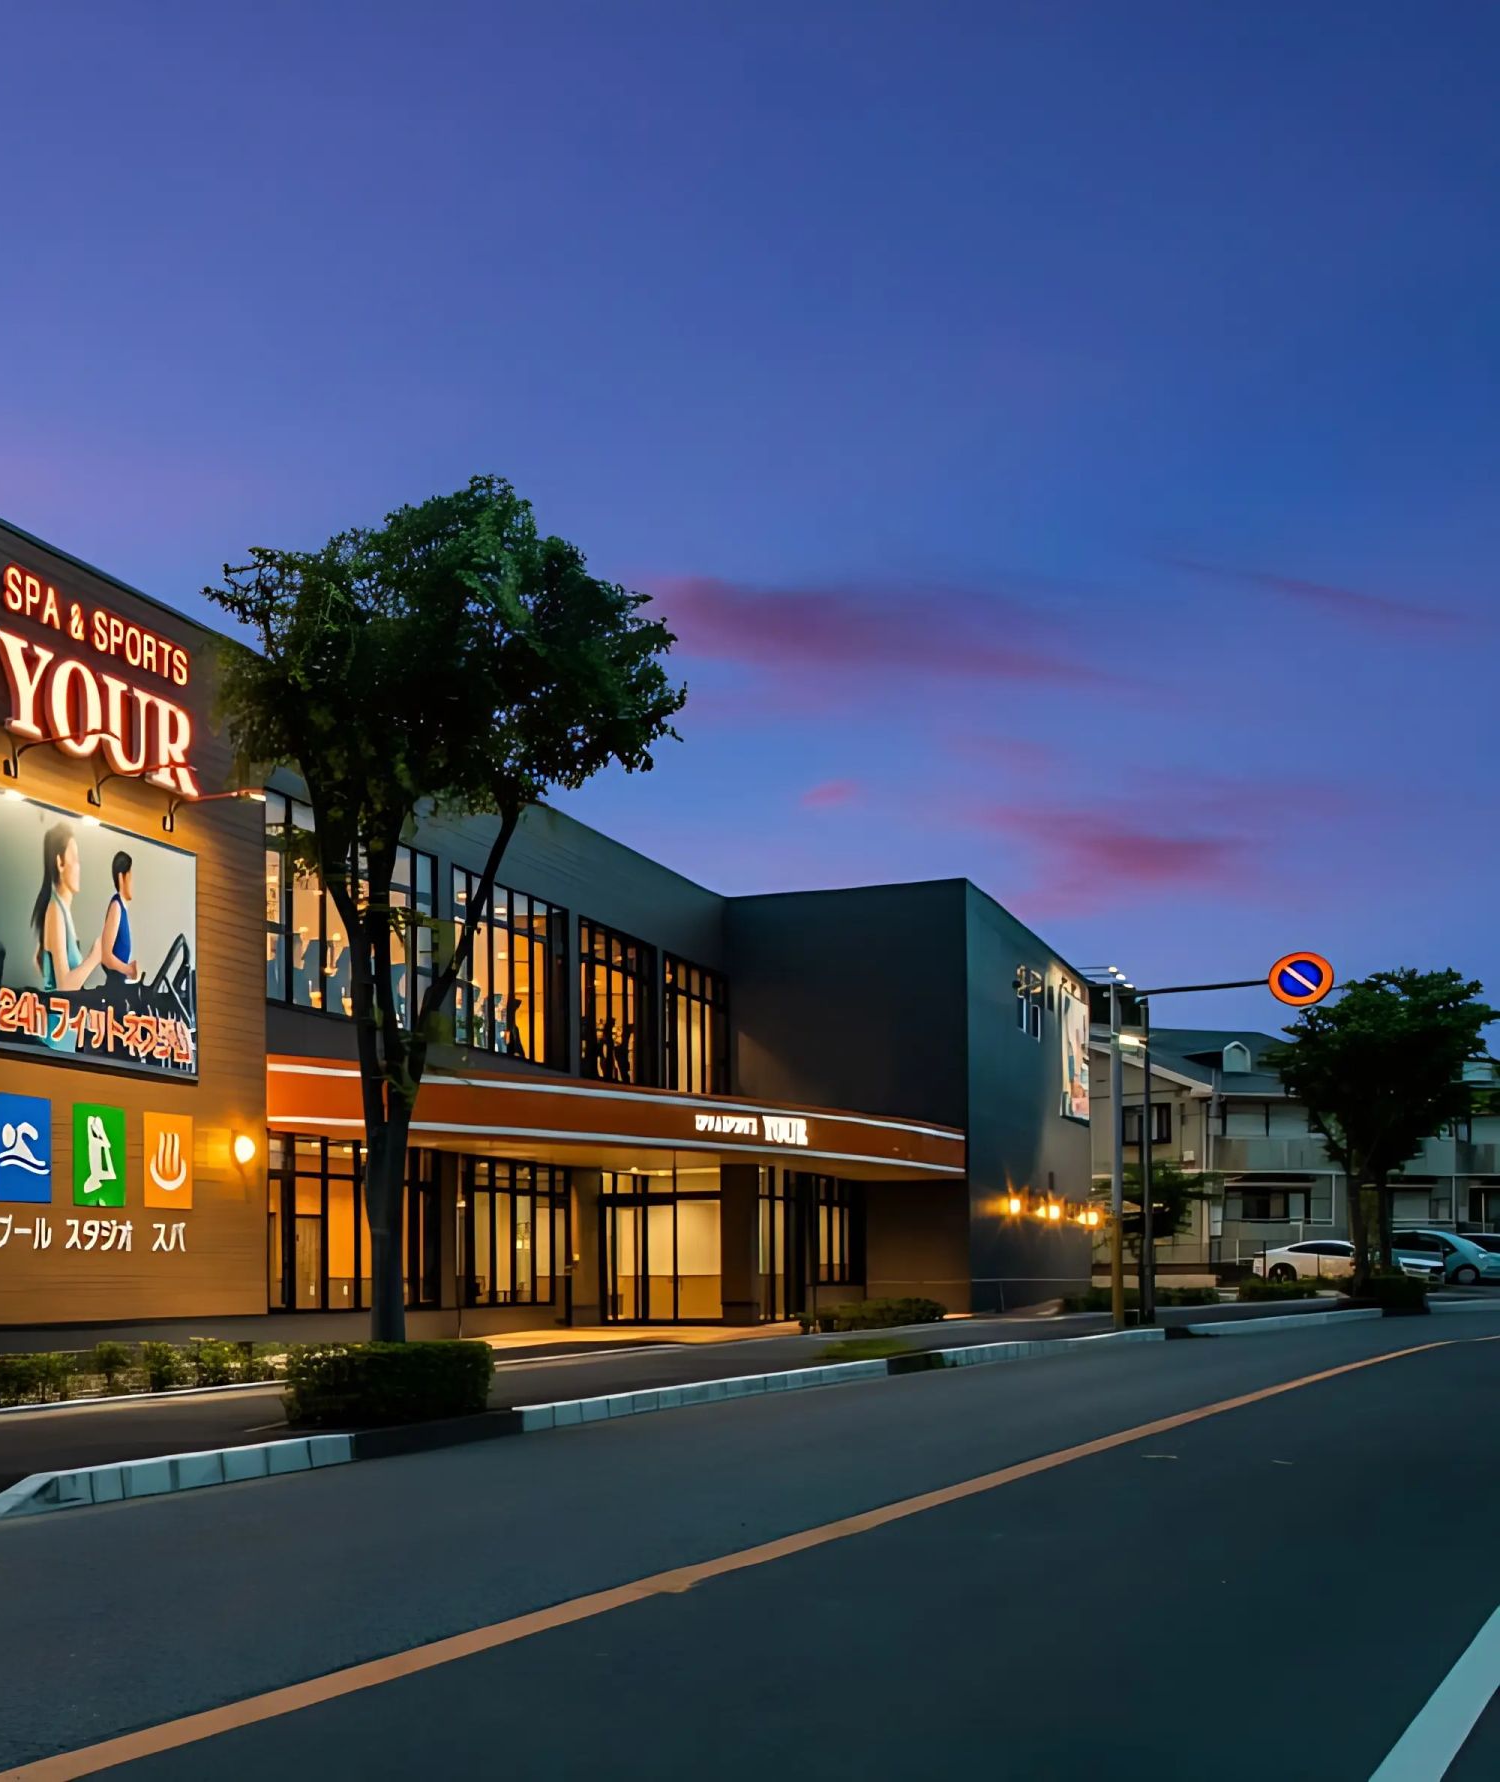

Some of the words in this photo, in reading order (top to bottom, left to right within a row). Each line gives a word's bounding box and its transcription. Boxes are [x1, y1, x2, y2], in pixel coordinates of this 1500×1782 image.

[5, 566, 61, 630] SPA
[69, 603, 85, 641] &
[92, 610, 189, 686] SPORTS
[65, 1219, 134, 1252] スタジオ
